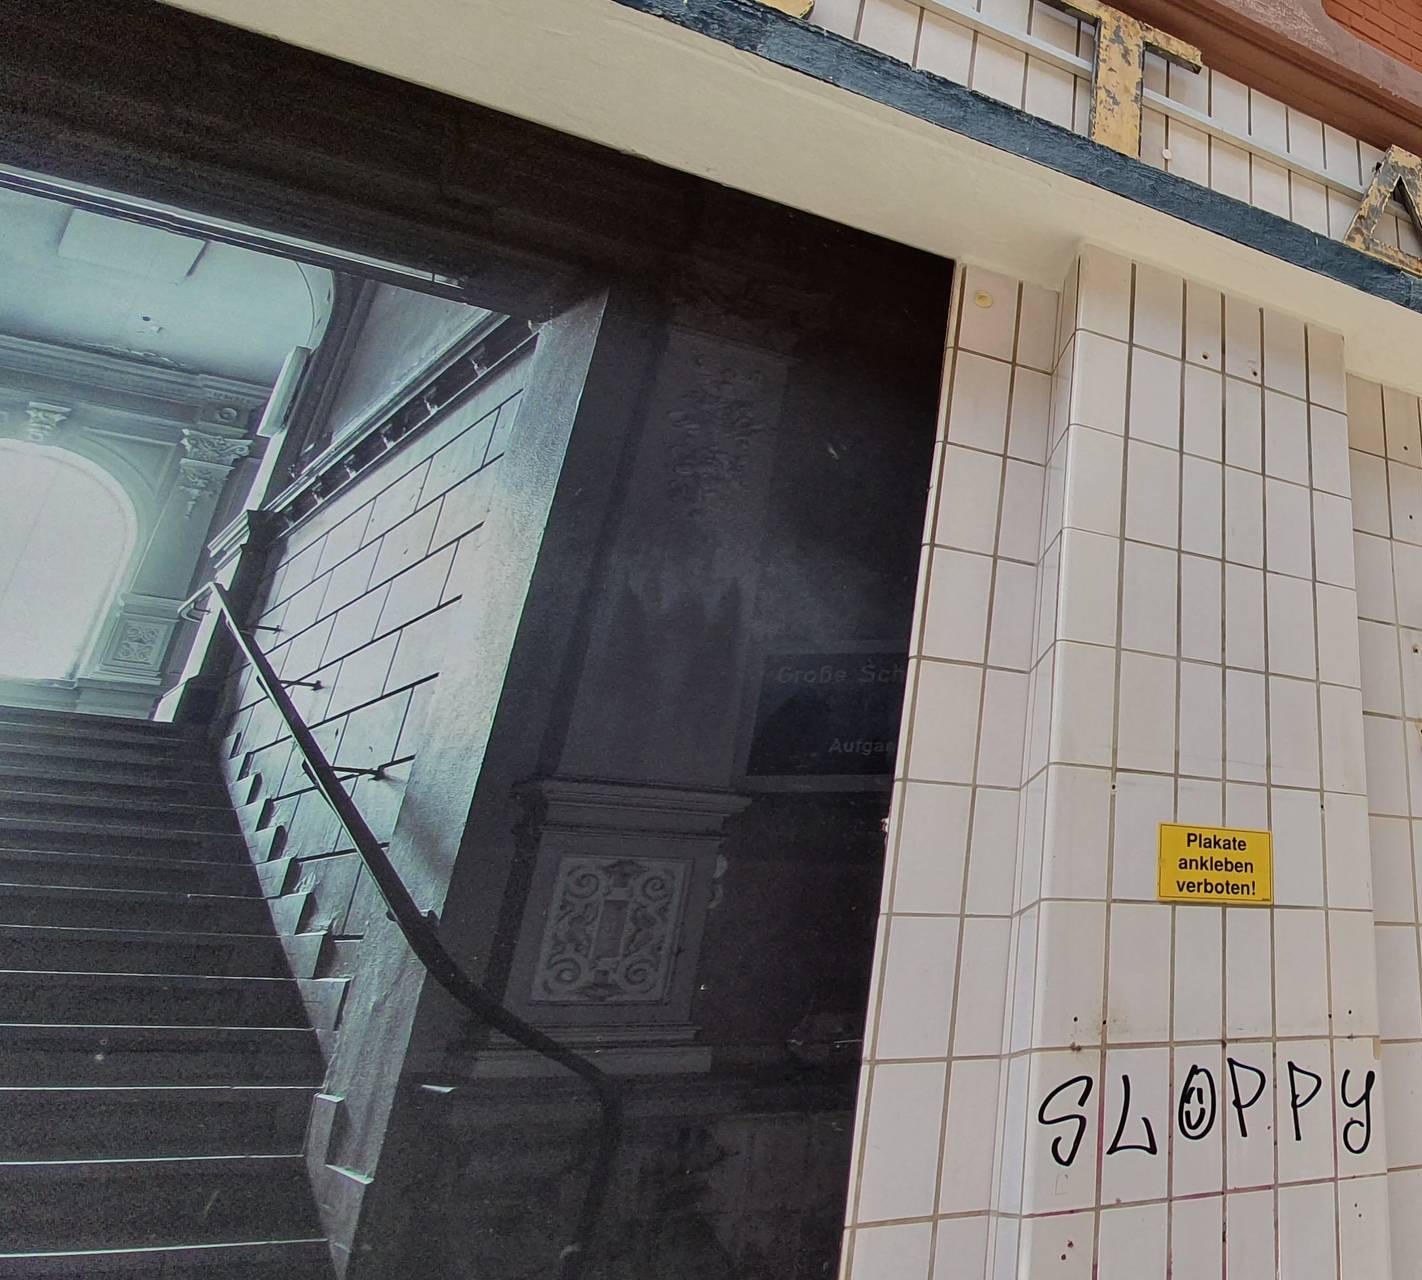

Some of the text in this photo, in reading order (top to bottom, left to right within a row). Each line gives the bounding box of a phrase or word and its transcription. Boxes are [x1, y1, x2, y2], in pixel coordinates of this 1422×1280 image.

[776, 664, 848, 685] Große
[1186, 832, 1247, 852] Plakate
[1178, 856, 1254, 874] ankleben
[1176, 878, 1256, 896] verboten!
